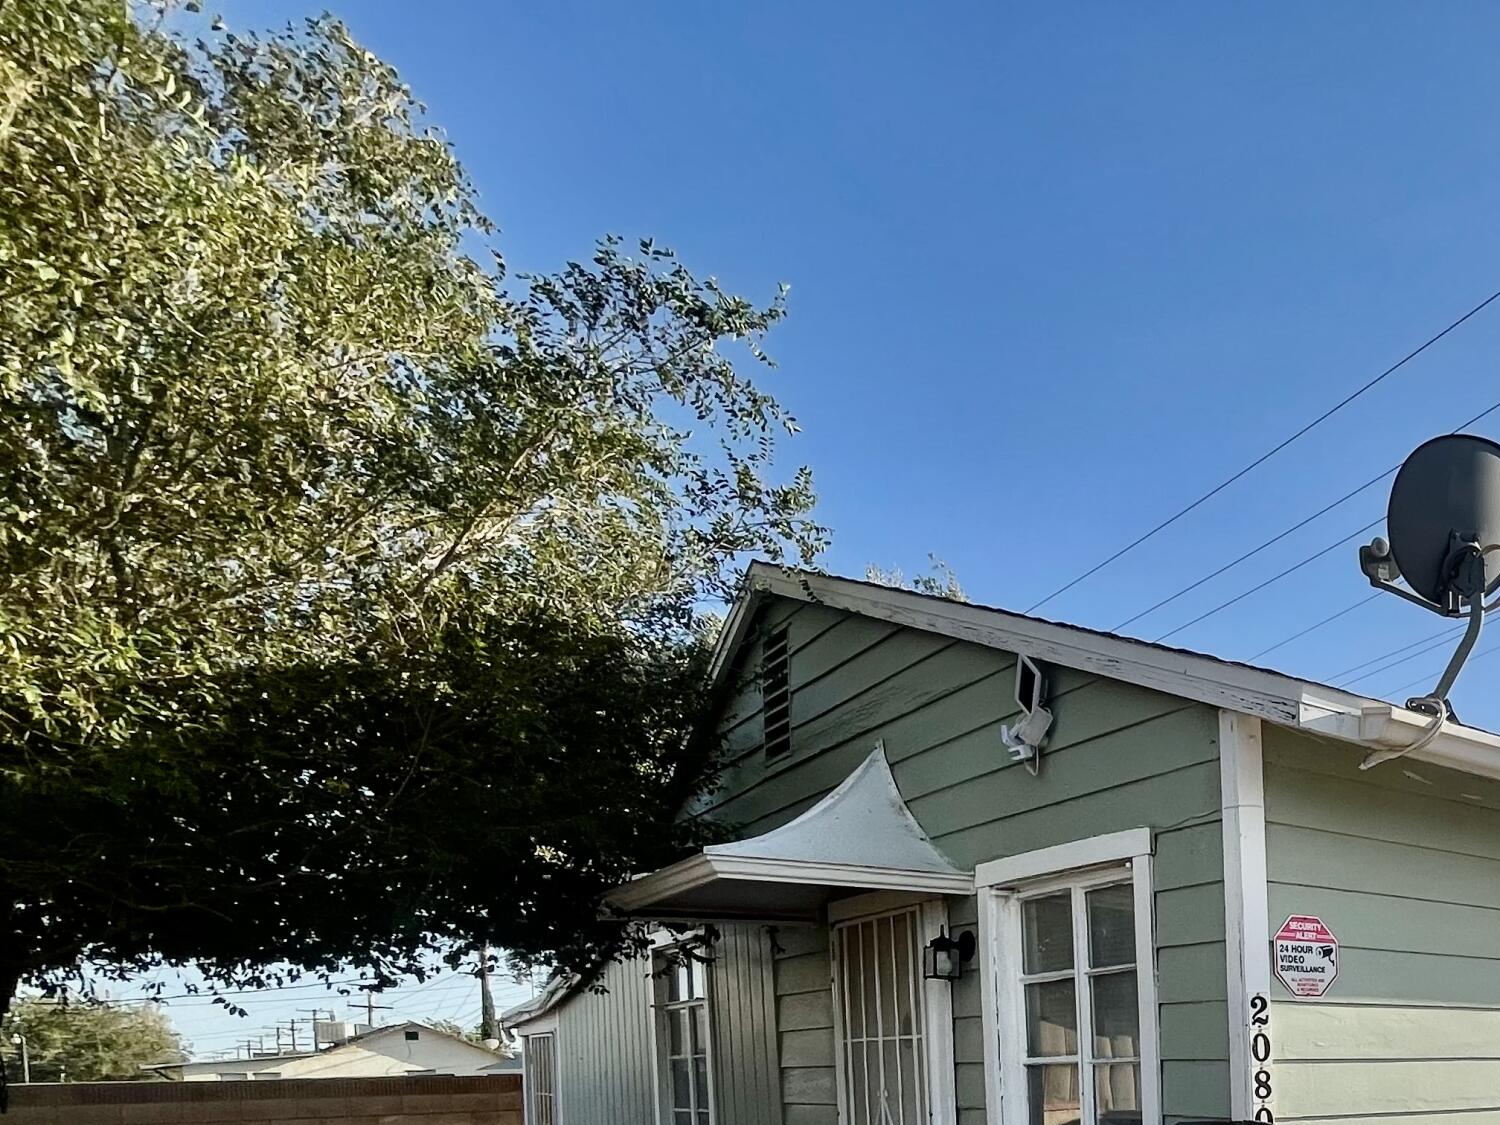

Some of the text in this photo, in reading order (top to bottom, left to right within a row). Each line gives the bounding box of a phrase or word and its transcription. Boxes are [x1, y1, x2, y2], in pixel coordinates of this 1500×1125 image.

[1288, 921, 1322, 931] SECURITY
[1295, 931, 1317, 939] ALERT
[1279, 944, 1313, 954] 24 HOUR
[1279, 955, 1305, 964] VIDEO
[1280, 965, 1325, 973] SURVEILLANCE
